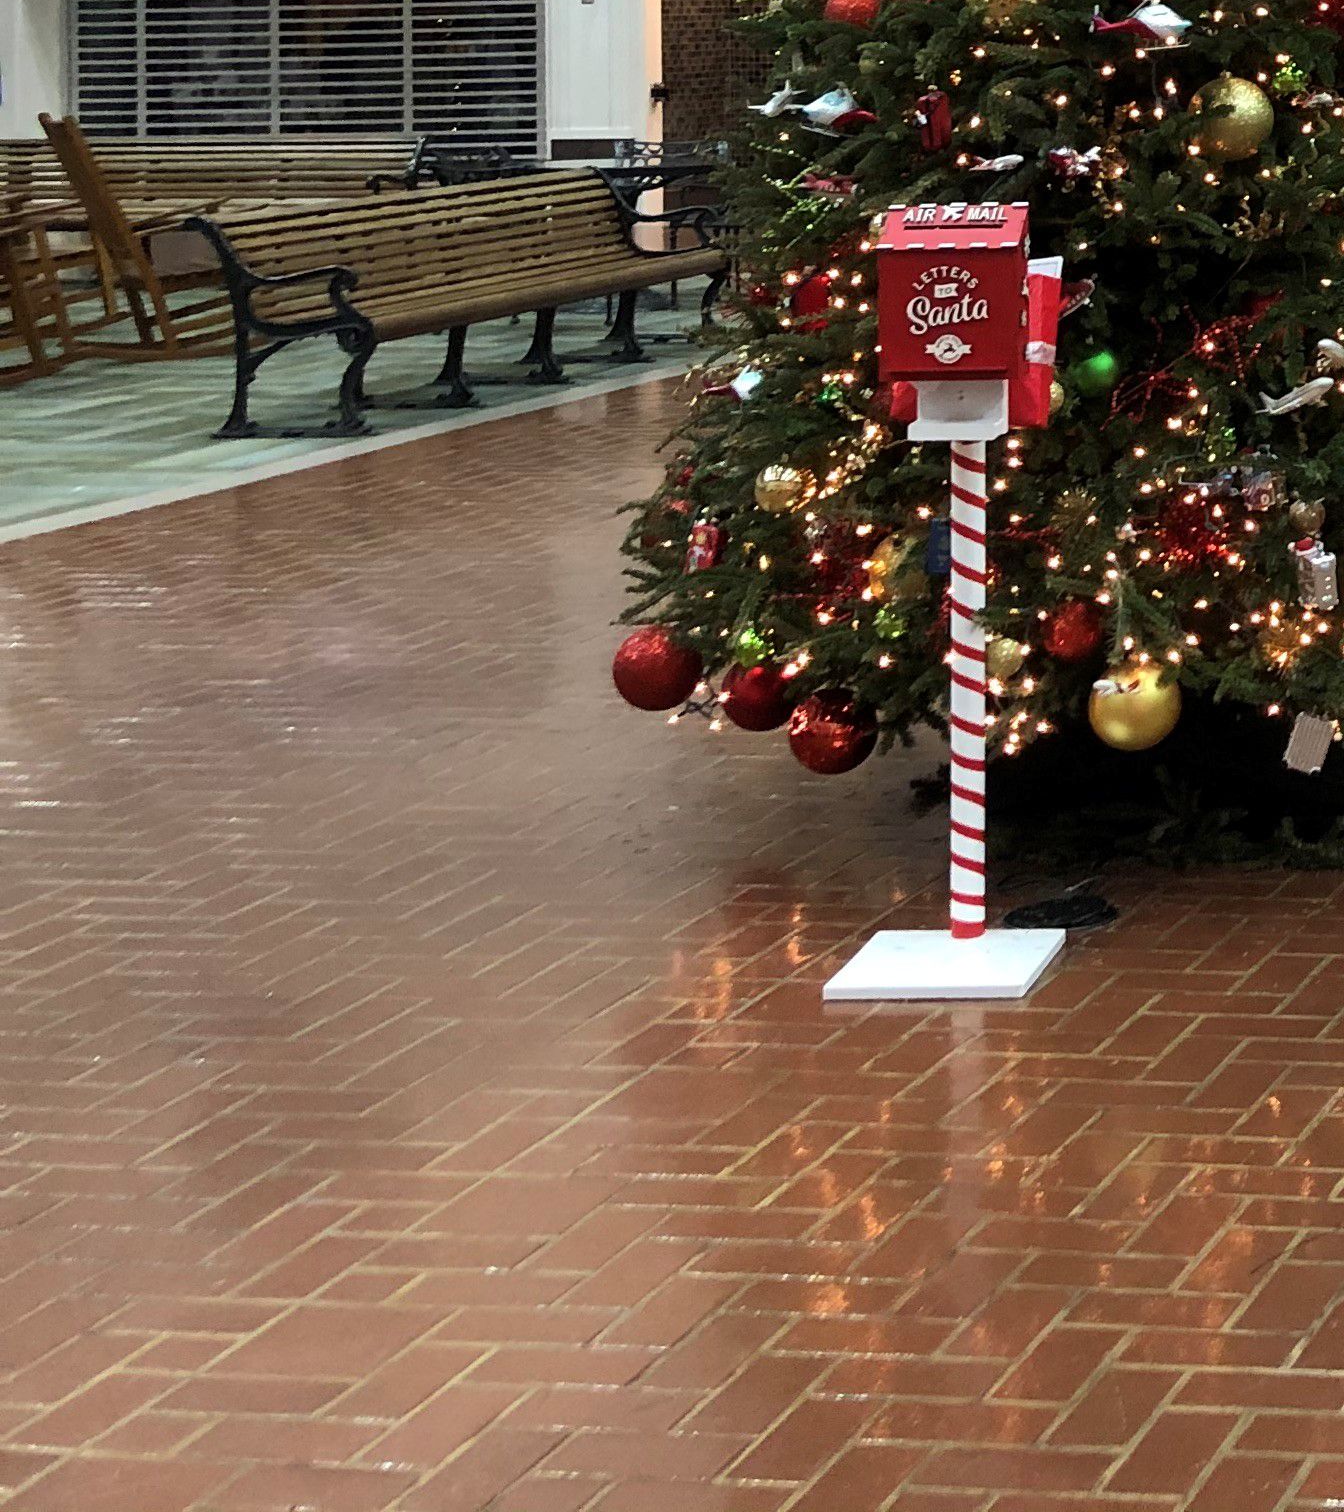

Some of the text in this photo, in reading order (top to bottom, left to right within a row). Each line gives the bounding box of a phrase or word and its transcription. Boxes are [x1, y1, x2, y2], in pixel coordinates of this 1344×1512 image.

[903, 207, 1008, 222] AIR MAIL
[912, 266, 978, 290] LETTERS
[938, 287, 953, 296] TO
[906, 293, 989, 335] Santa
